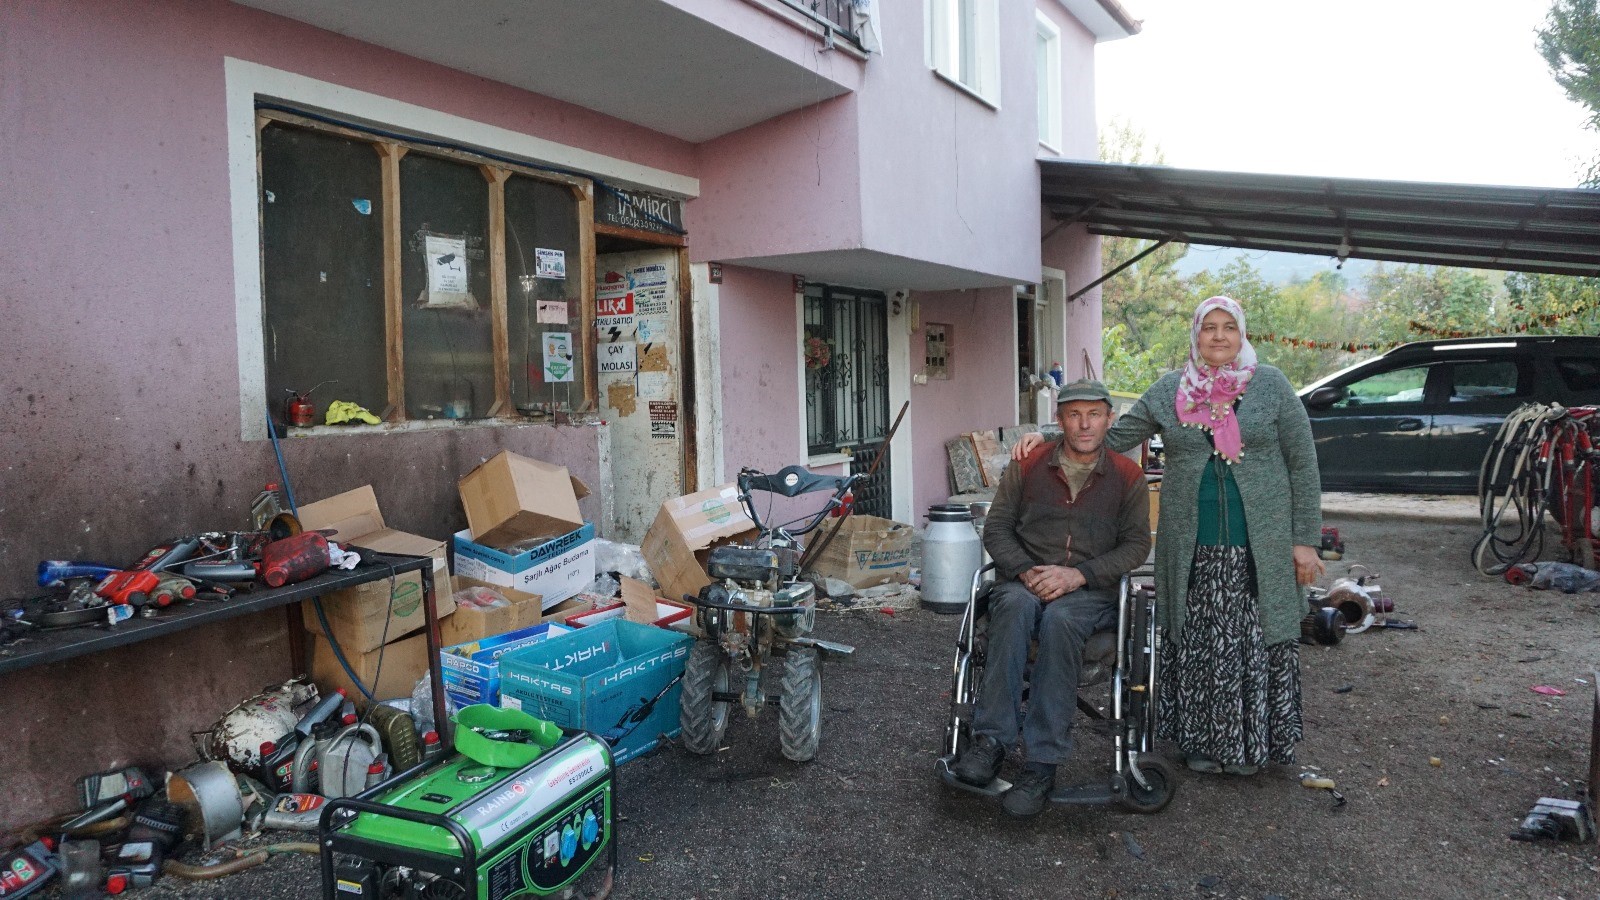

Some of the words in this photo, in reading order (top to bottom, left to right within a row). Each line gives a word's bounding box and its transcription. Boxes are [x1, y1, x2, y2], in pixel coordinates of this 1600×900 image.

[612, 316, 633, 325] SATICI
[608, 346, 624, 356] ÇAY
[601, 361, 633, 371] MOLASI
[530, 530, 582, 561] DAWREEK
[524, 571, 543, 584] Şarjlı
[544, 562, 562, 574] Ağaç
[562, 548, 590, 567] Budama
